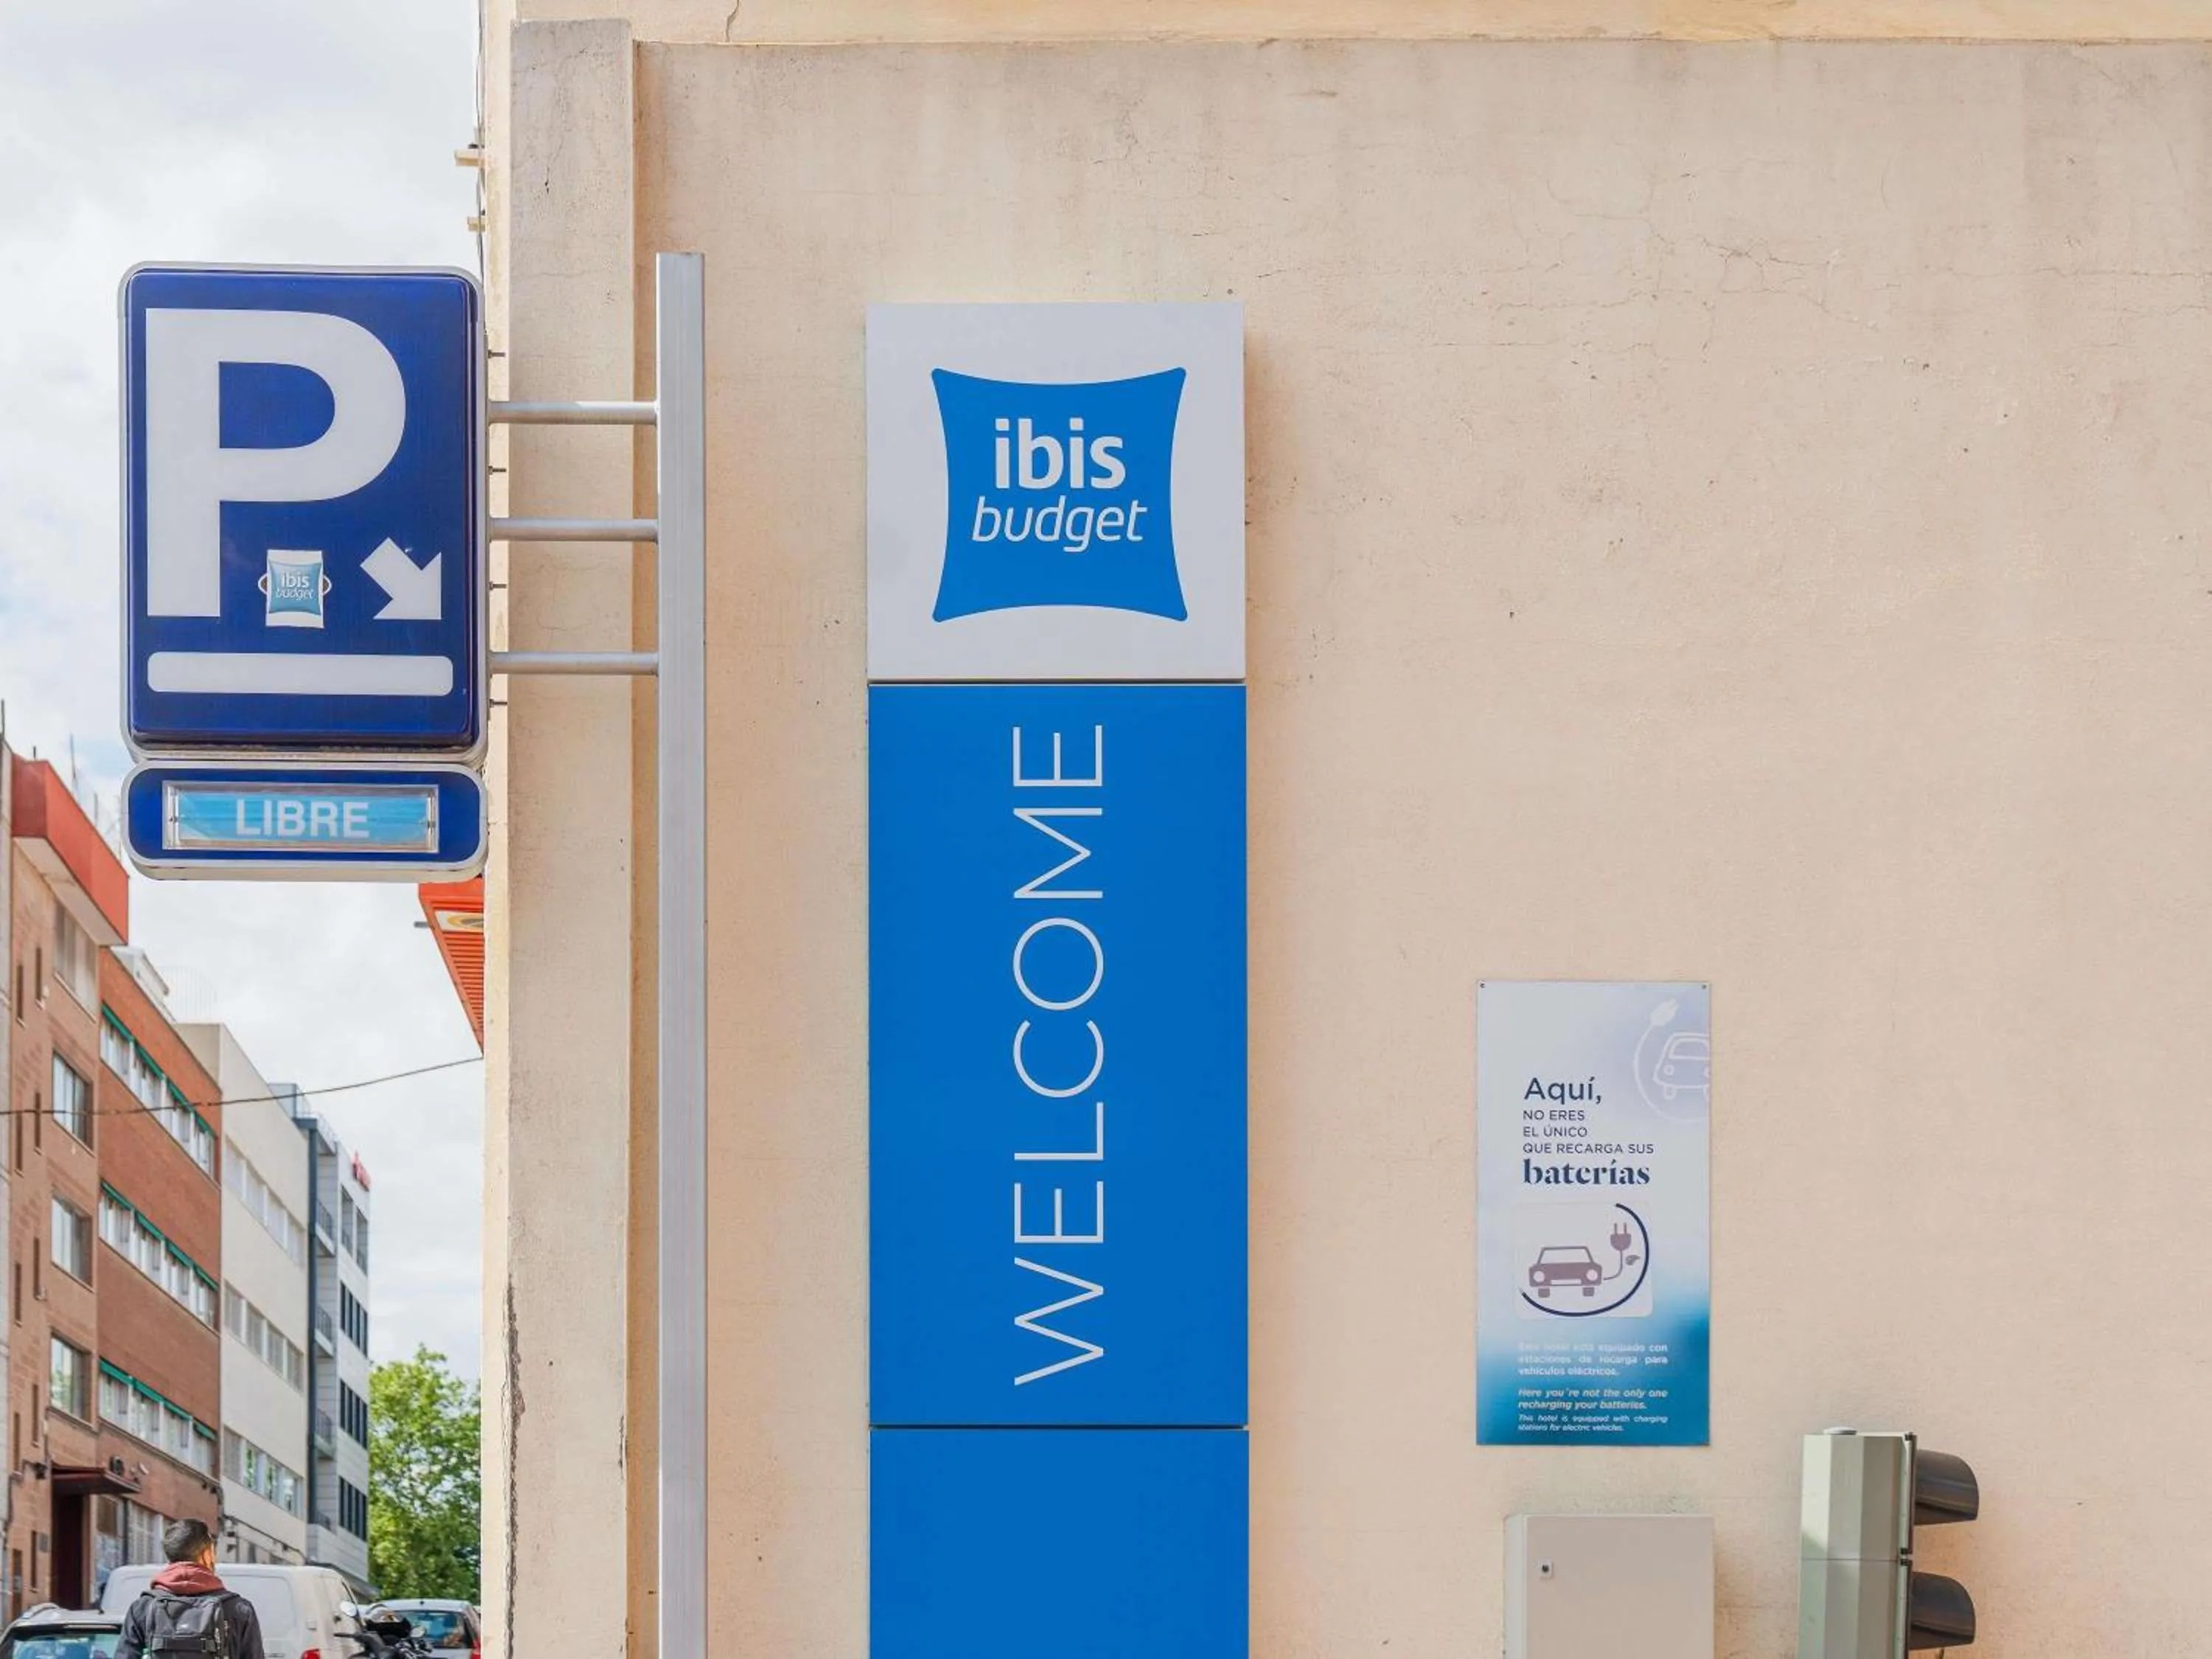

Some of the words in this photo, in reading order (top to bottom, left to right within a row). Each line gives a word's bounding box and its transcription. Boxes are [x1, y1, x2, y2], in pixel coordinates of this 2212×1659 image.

[995, 417, 1127, 490] ibis
[146, 307, 406, 617] P
[972, 495, 1147, 553] budget
[281, 571, 310, 588] ibis
[275, 588, 316, 601] budget
[235, 799, 370, 838] LIBRE
[1012, 723, 1105, 1387] WELCOME
[1523, 1076, 1602, 1105] Aquí,
[1523, 1110, 1545, 1121] NO
[1549, 1110, 1585, 1121] ERES
[1523, 1127, 1539, 1138] EL
[1543, 1124, 1587, 1138] ÚNICO
[1523, 1143, 1552, 1155] QUE
[1557, 1143, 1623, 1155] RECARGA
[1627, 1143, 1655, 1155] SUS
[1522, 1158, 1651, 1186] baterías
[1649, 1343, 1669, 1353] con
[1644, 1355, 1669, 1366] para
[1518, 1388, 1542, 1397] Here
[1583, 1389, 1600, 1397] not
[1603, 1388, 1621, 1397] the
[1624, 1388, 1645, 1399] only
[1648, 1390, 1669, 1398] one
[1518, 1399, 1573, 1410] recharging
[1574, 1401, 1598, 1410] your
[1599, 1399, 1647, 1410] batteries.
